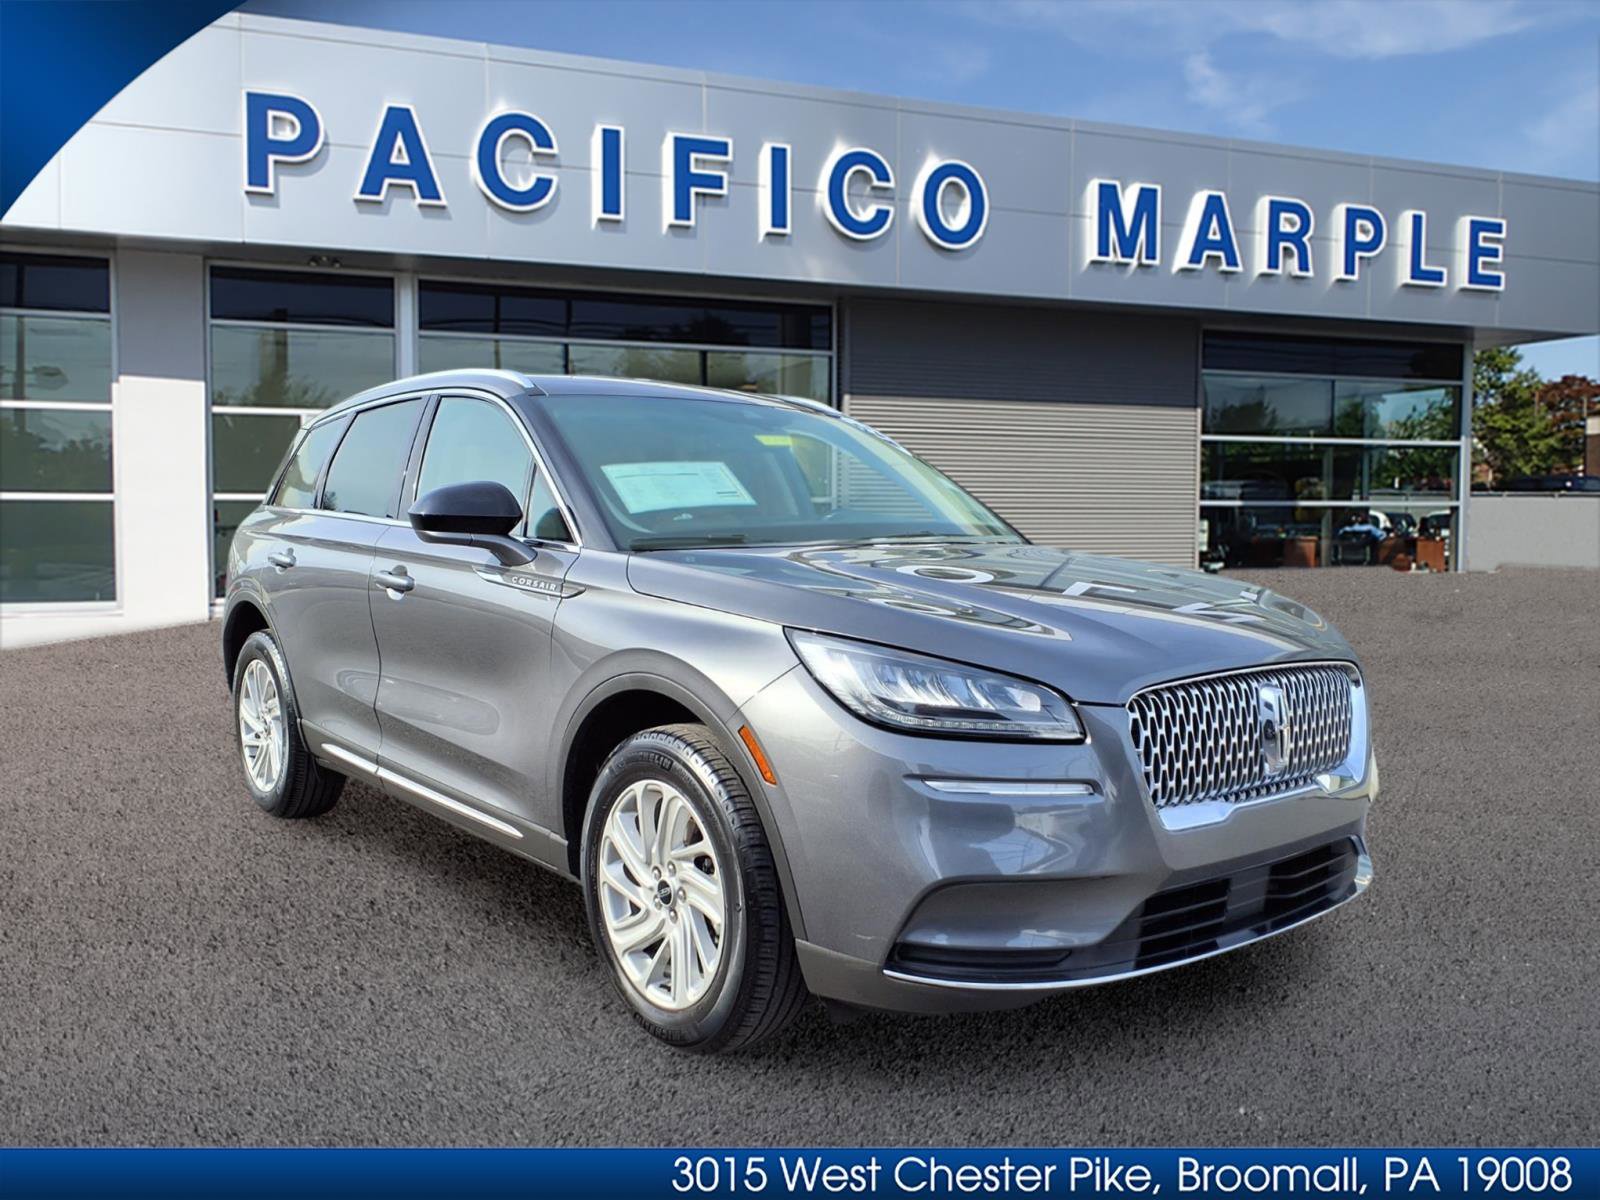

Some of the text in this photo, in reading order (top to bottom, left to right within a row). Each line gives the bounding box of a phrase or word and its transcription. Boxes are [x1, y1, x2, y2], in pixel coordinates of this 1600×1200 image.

[243, 88, 1506, 291] PACIFICO MARPLE
[511, 576, 557, 591] CORSAIR
